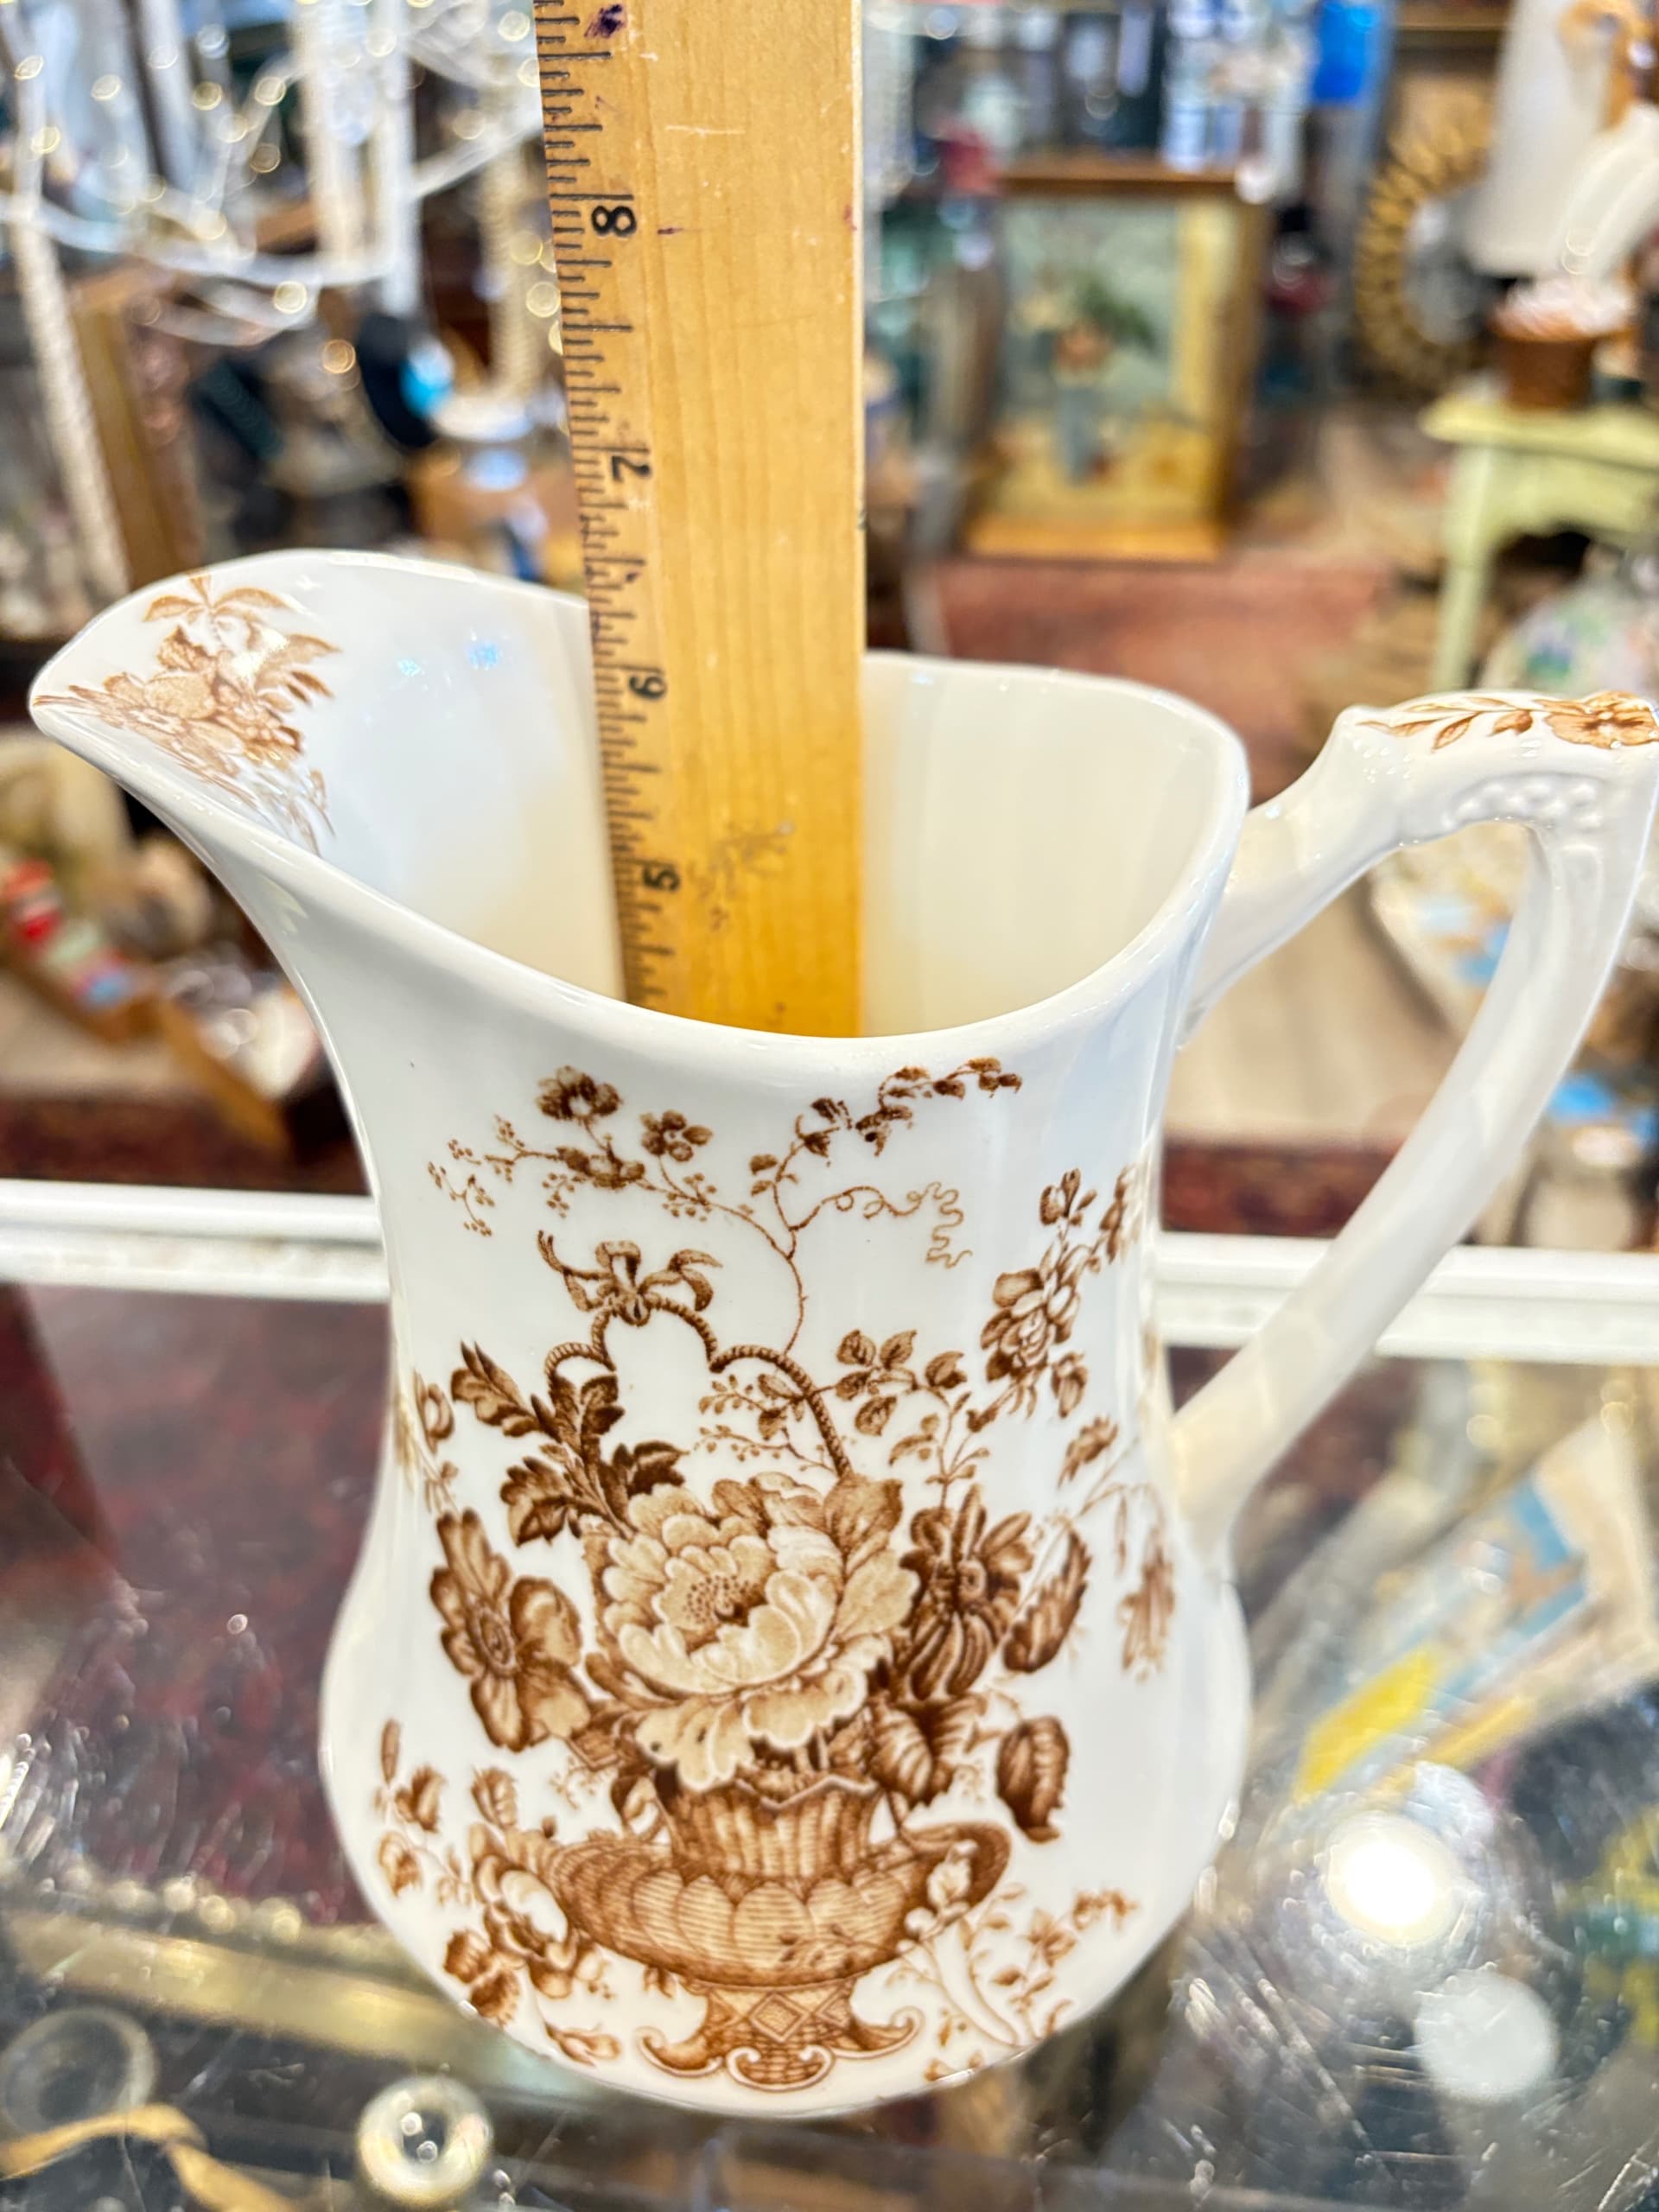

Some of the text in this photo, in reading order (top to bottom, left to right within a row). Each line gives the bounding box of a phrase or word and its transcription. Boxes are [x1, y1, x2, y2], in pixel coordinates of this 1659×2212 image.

[591, 206, 637, 237] 8
[612, 455, 651, 483] 7
[629, 675, 667, 700] 6
[642, 864, 681, 893] 5
